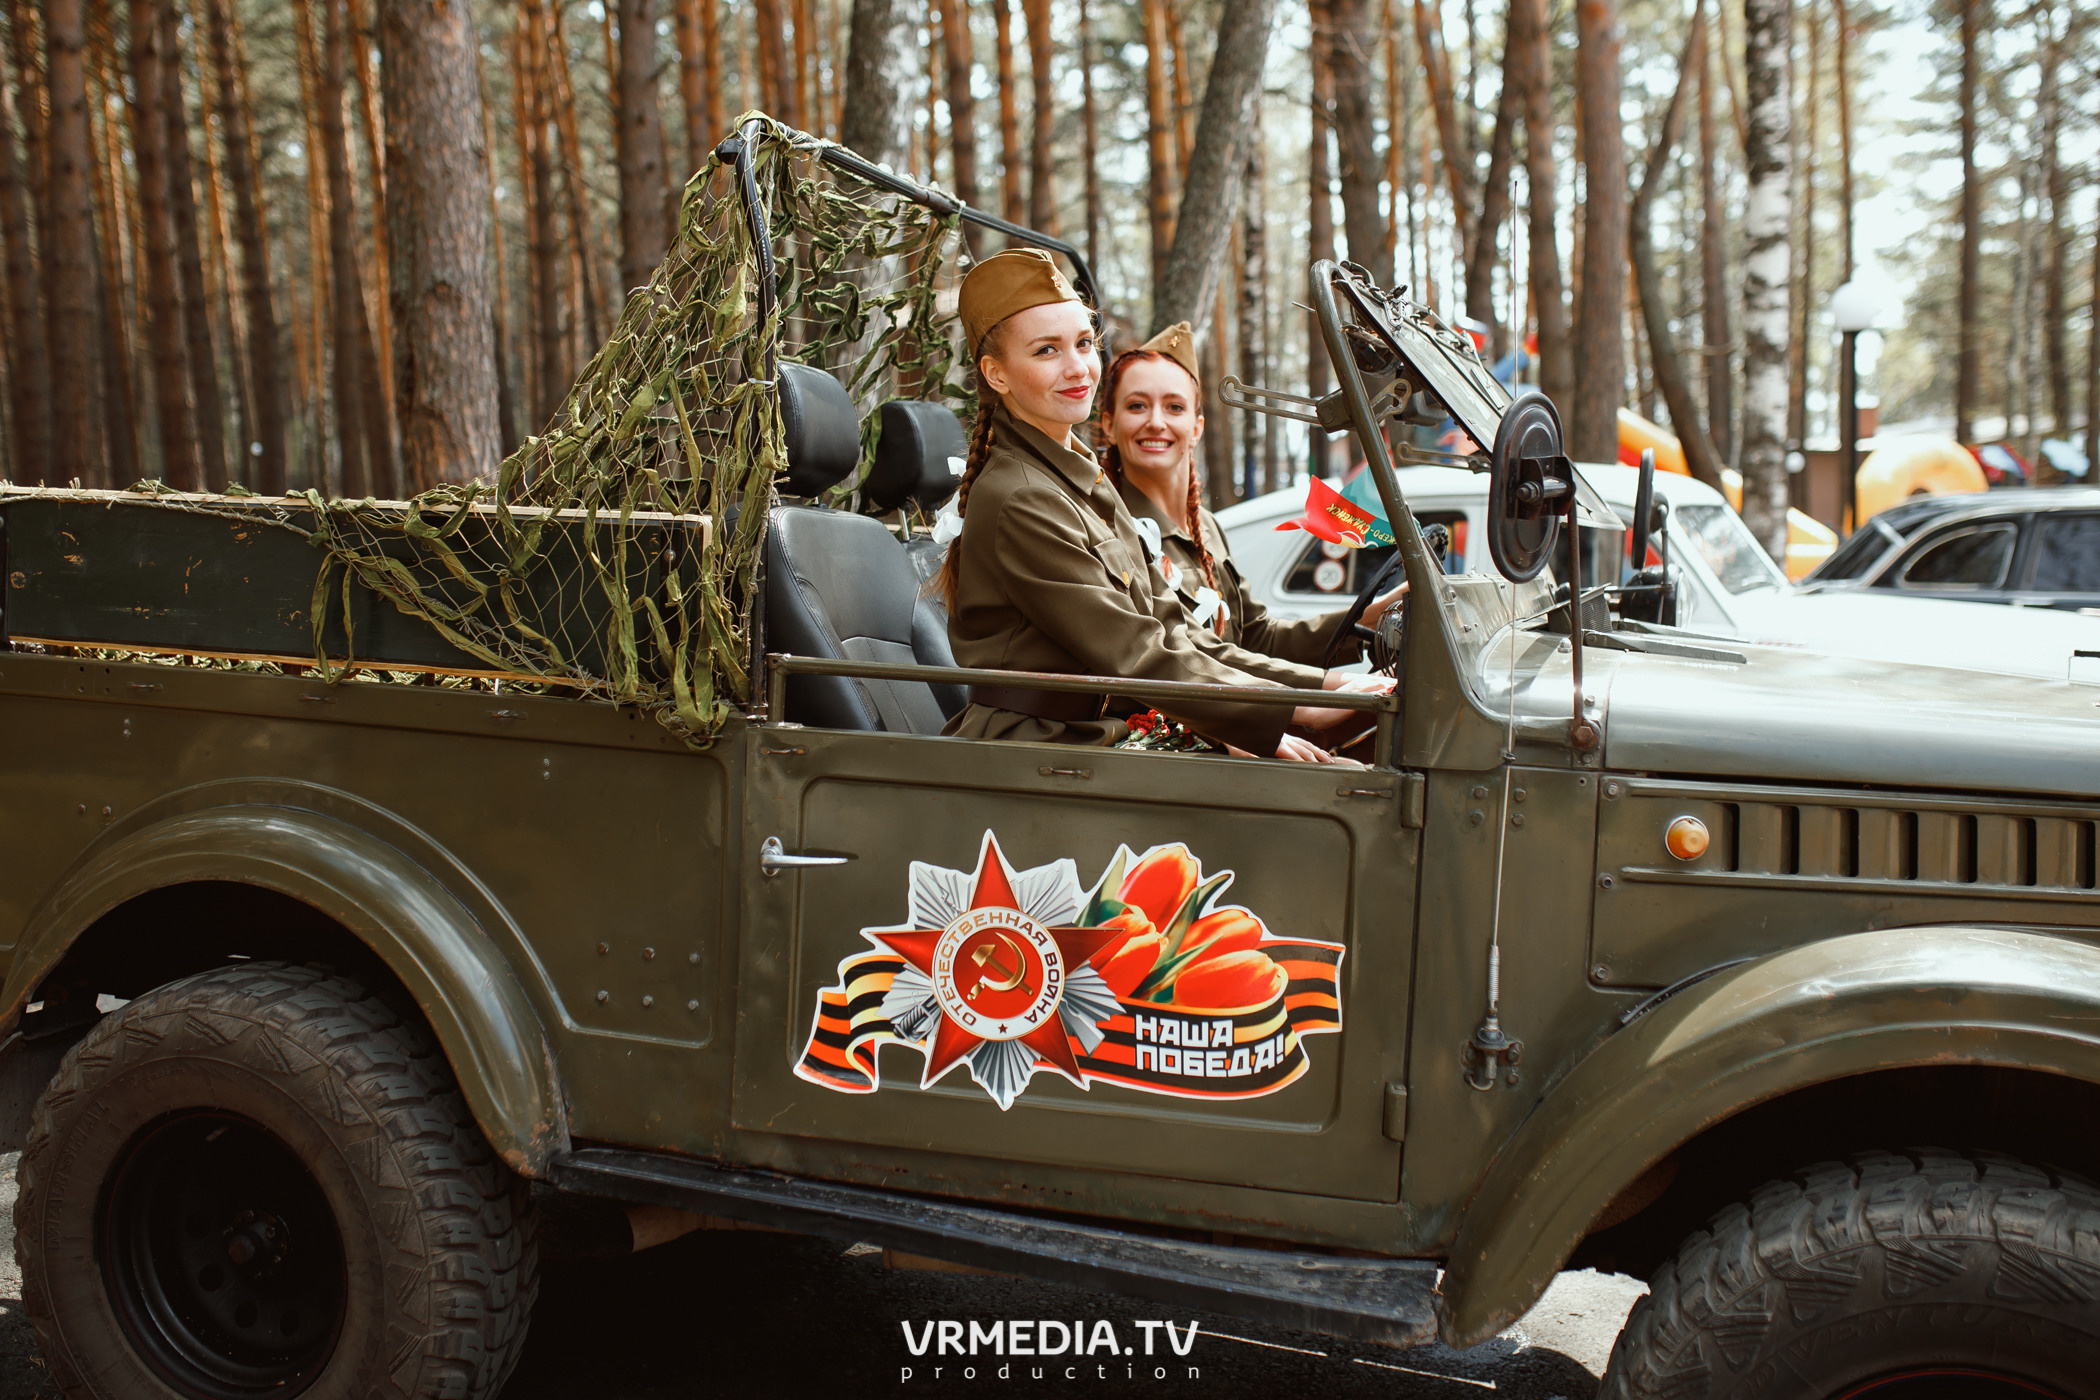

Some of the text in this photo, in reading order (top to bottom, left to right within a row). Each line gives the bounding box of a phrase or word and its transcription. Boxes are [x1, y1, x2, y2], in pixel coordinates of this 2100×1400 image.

[1326, 503, 1397, 546] ЖЕРО-СУДЖЕНСК
[938, 912, 1048, 1026] ОТЕЧЕСТВЕННАЯ
[1135, 1013, 1234, 1048] НАША
[1136, 1033, 1285, 1078] ПОБЕДА!
